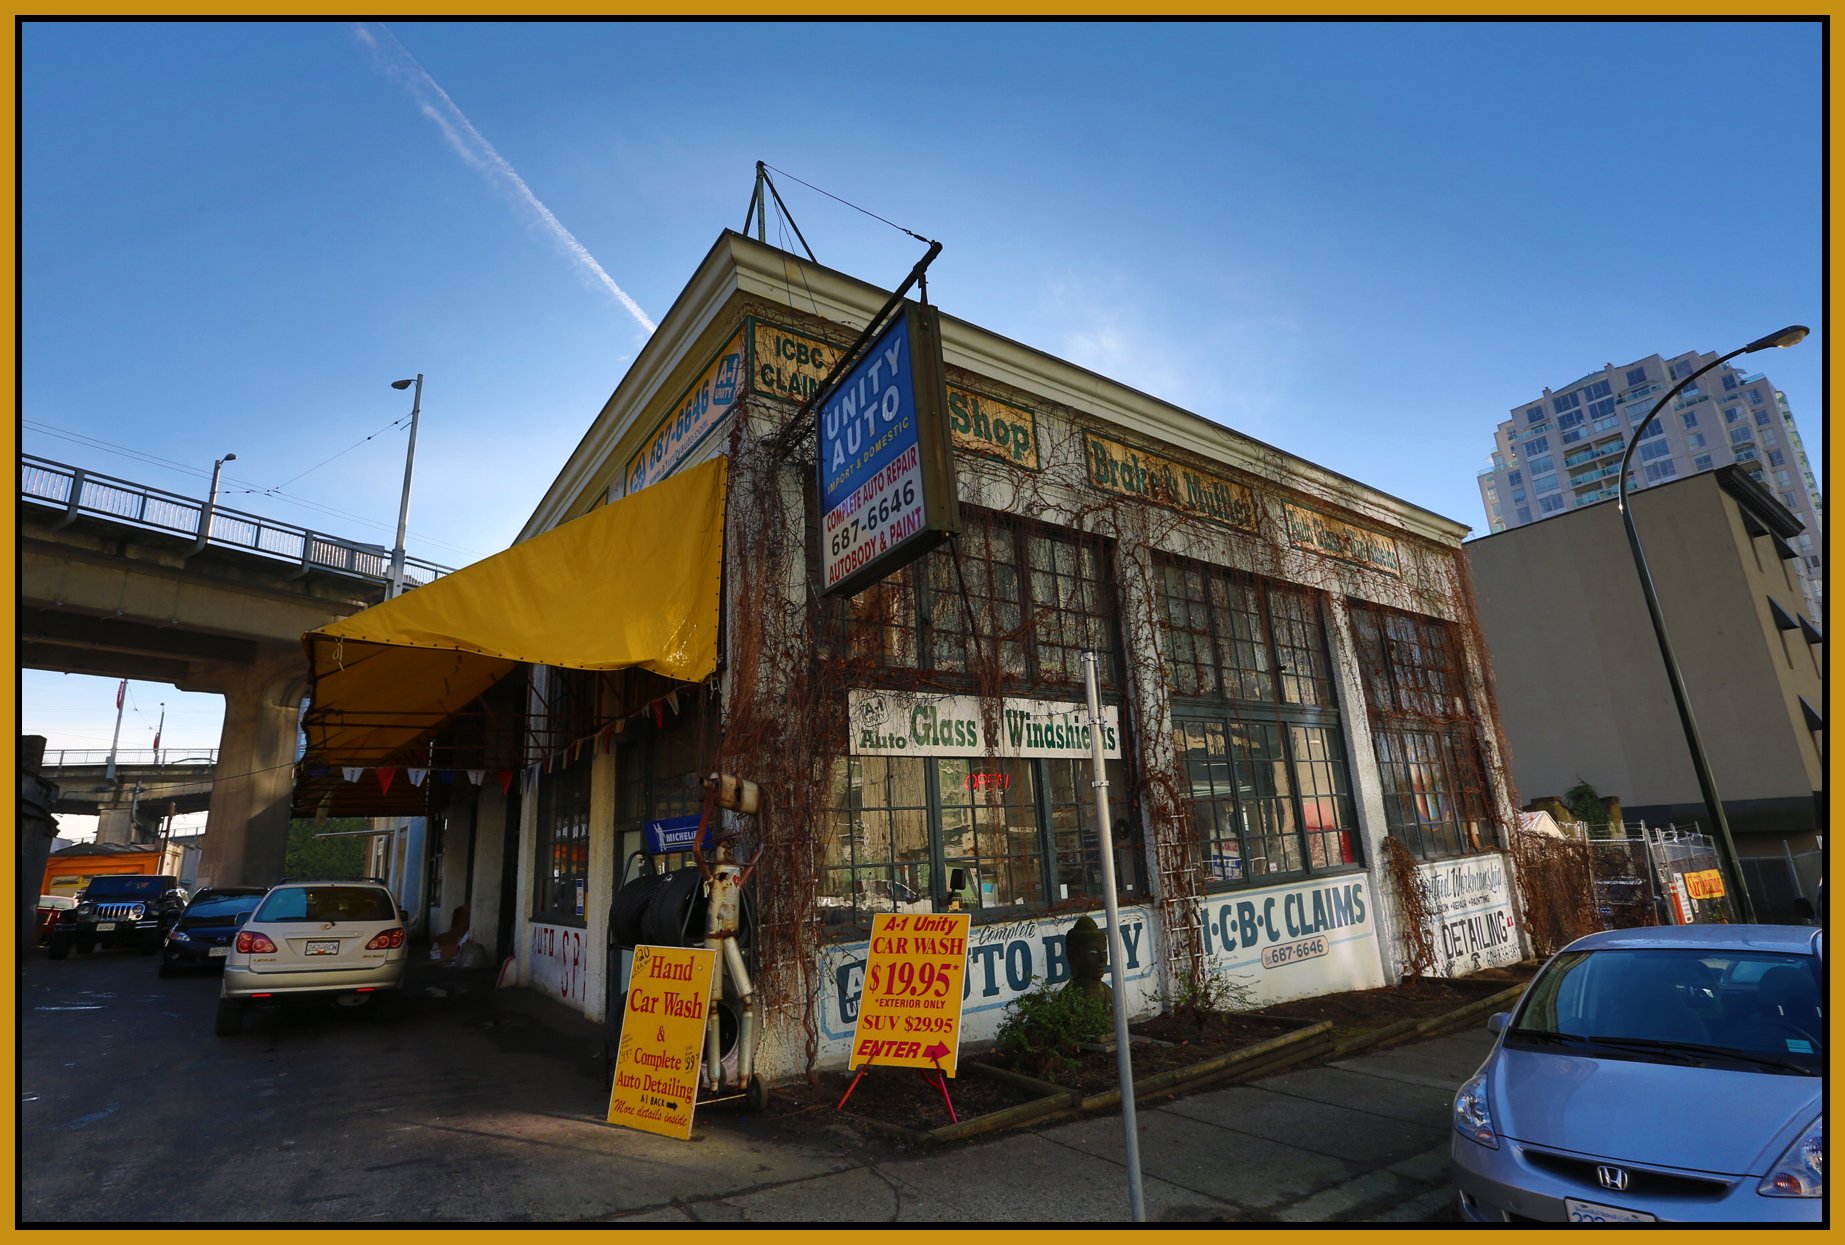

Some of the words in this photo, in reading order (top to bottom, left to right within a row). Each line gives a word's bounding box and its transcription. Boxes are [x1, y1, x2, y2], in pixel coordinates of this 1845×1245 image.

[775, 336, 824, 369] ICBC
[714, 386, 733, 400] UNITY
[827, 336, 901, 441] UNITY
[649, 378, 710, 471] 687-6646
[831, 384, 901, 473] AUTO
[950, 392, 1031, 461] Shop
[827, 465, 855, 495] IMPORT
[856, 458, 862, 469] &
[863, 416, 909, 463] DOMESTIC
[827, 491, 862, 533] COMPLETE
[862, 473, 885, 506] AUTO
[886, 446, 918, 487] REPAIR
[831, 479, 915, 557] 687-6646
[828, 535, 877, 586] AUTOBODY
[879, 530, 888, 553] &
[889, 505, 922, 546] PAINT
[859, 729, 908, 750] Auto
[911, 704, 978, 748] Glass
[1005, 708, 1116, 751] Windshies
[883, 916, 910, 932] A-1
[913, 916, 959, 936] Unity
[1284, 883, 1366, 938] CLAIMS
[532, 926, 554, 957] AUTO
[872, 936, 908, 955] CAR
[914, 937, 965, 956] WASH
[979, 919, 1037, 945] Complete
[1441, 910, 1508, 960] DETAILING
[649, 955, 695, 981] Hand
[630, 988, 660, 1014] Car
[663, 991, 703, 1019] Wash
[923, 1000, 946, 1010] ONLY
[656, 1025, 665, 1042] &
[862, 1014, 900, 1031] SUV
[904, 1015, 954, 1034] $29.95
[634, 1047, 682, 1072] Complete
[856, 1039, 922, 1059] ENTER
[616, 1070, 641, 1090] Auto
[642, 1074, 694, 1105] Detailing
[650, 1096, 665, 1107] BACK
[613, 1098, 634, 1115] More
[637, 1105, 662, 1121] details
[664, 1112, 687, 1126] inside
